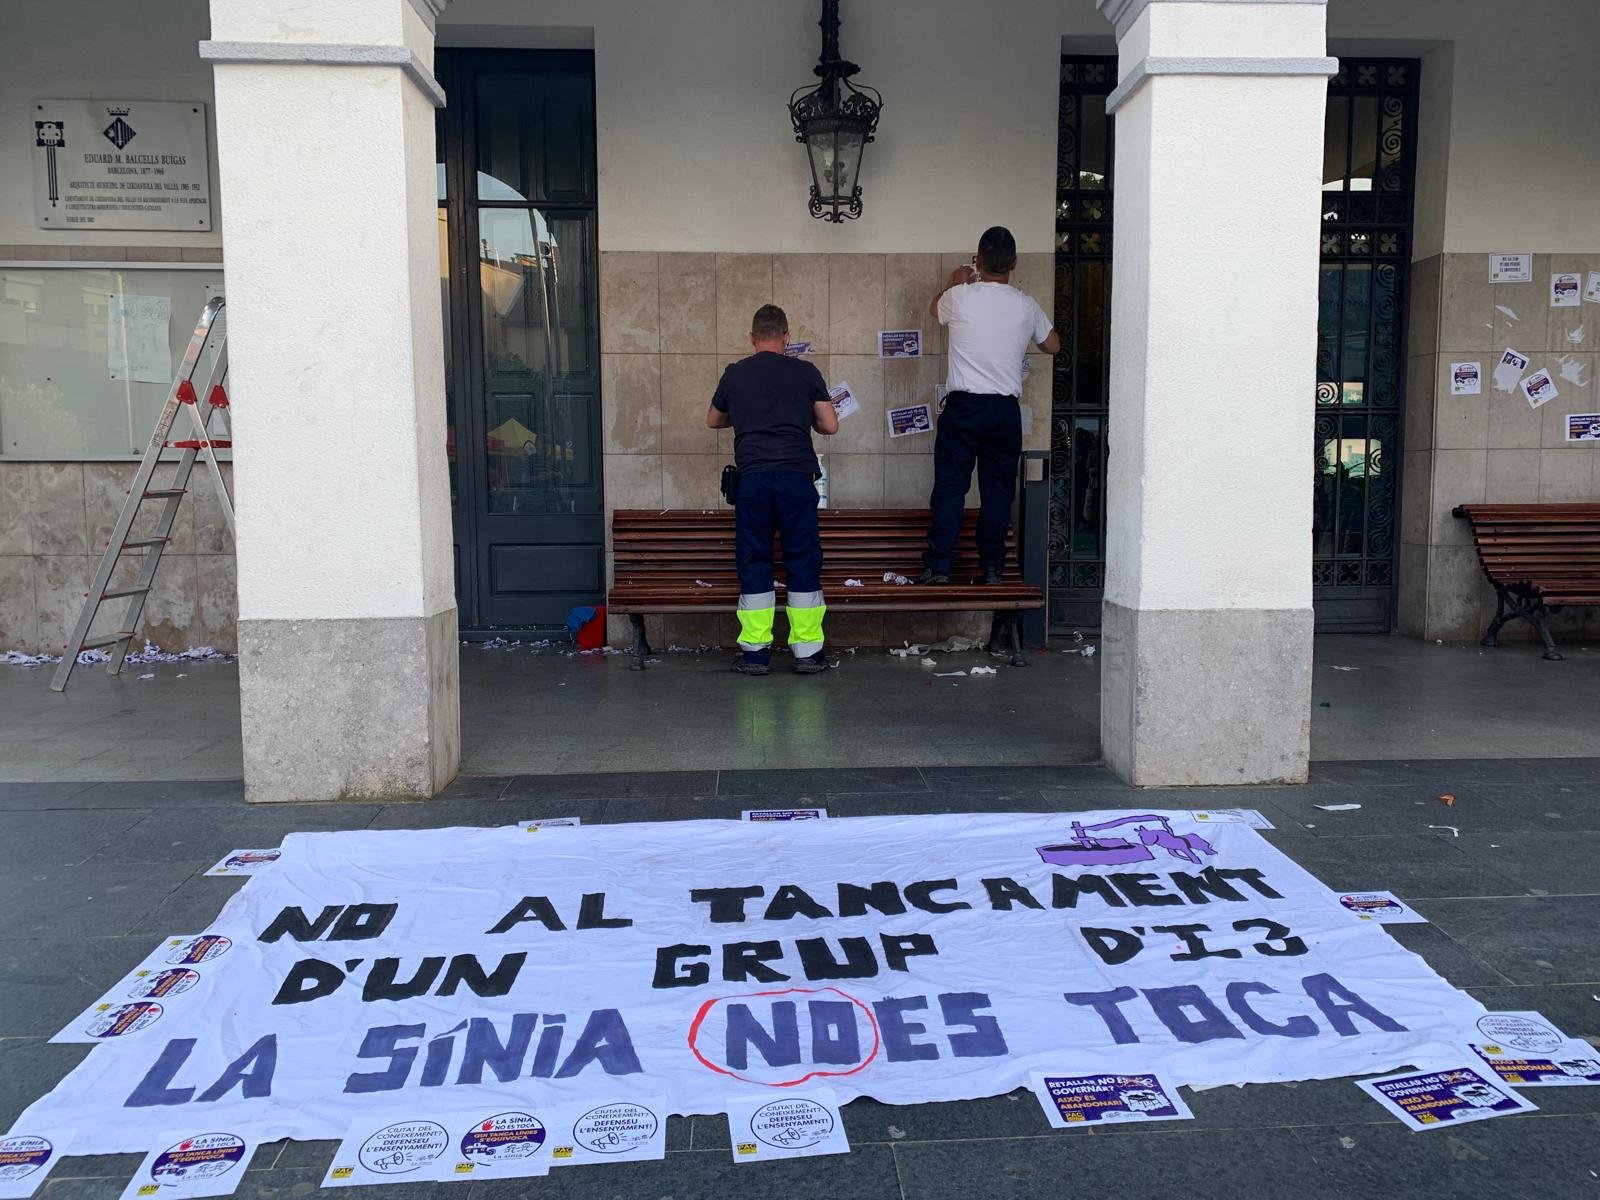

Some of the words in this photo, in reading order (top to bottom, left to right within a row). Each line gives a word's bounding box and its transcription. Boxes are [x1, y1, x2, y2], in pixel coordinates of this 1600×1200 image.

[84, 153, 112, 164] EDUARD
[115, 154, 122, 164] M.
[126, 154, 159, 164] BALCELLS
[257, 903, 398, 943] NO
[485, 893, 633, 934] AL
[689, 866, 1285, 923] TANCAMENT
[272, 952, 527, 1005] D'UN
[652, 933, 938, 988] GRUP
[123, 1034, 277, 1107] LA
[726, 1001, 861, 1070] NO
[872, 992, 1008, 1062] ES
[1064, 973, 1410, 1044] TOCA
[1049, 1080, 1096, 1088] RETALLAR
[1378, 1080, 1423, 1091] RETALLAR
[1422, 1076, 1439, 1084] NO
[1053, 1085, 1114, 1095] GOVERNAR?
[1061, 1100, 1122, 1109] ABANDONAR!
[760, 1108, 821, 1117] CONEIXEMENT?
[510, 1116, 533, 1124] SÍNIA
[770, 1114, 812, 1122] DEFENSEU
[580, 1124, 652, 1133] L'ENSENYAMENT!
[757, 1119, 828, 1130] L'ENSENYAMENT!
[376, 1131, 443, 1140] CONEIXEMENT?
[366, 1143, 442, 1153] L'ENSENYAMENT!
